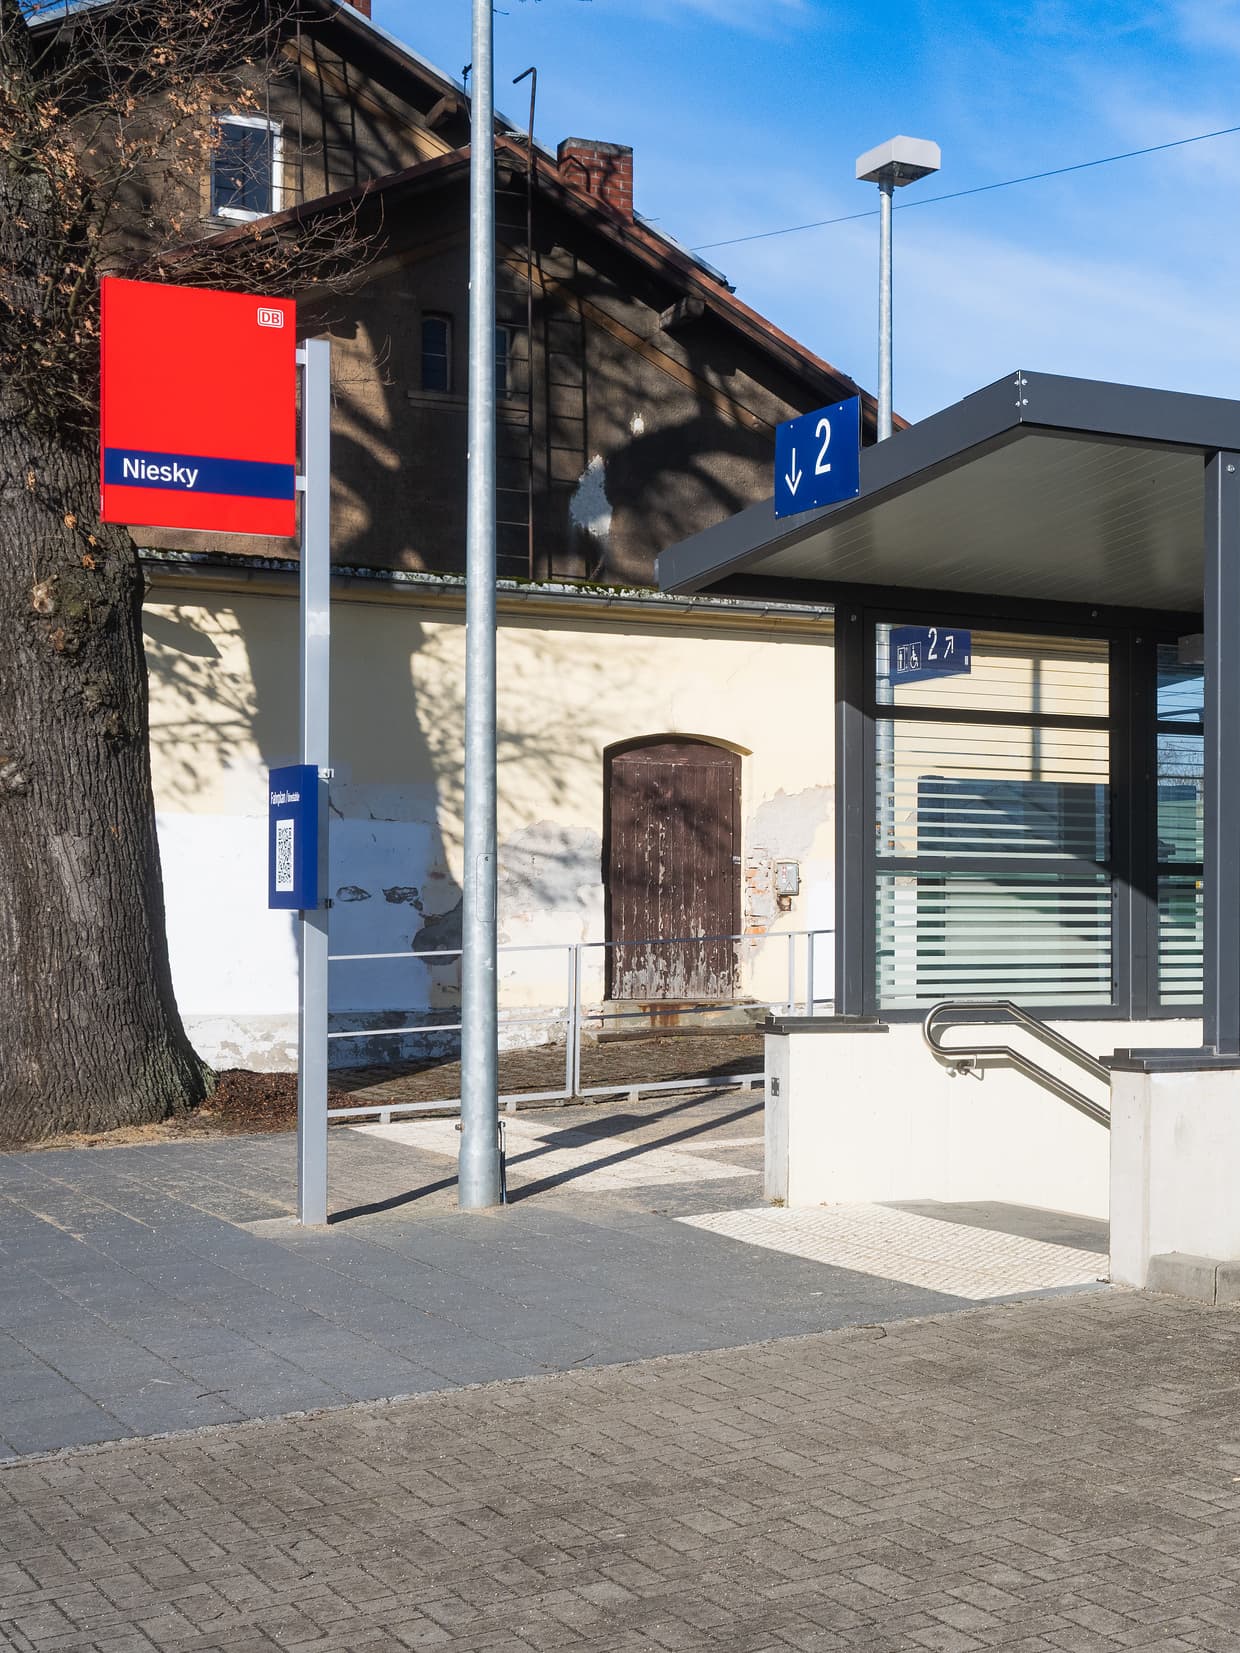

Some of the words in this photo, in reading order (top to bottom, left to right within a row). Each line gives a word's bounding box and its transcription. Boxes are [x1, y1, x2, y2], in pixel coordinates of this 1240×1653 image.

[261, 311, 280, 325] DB
[815, 418, 831, 476] 2
[122, 457, 199, 488] Niesky
[927, 627, 938, 661] 2
